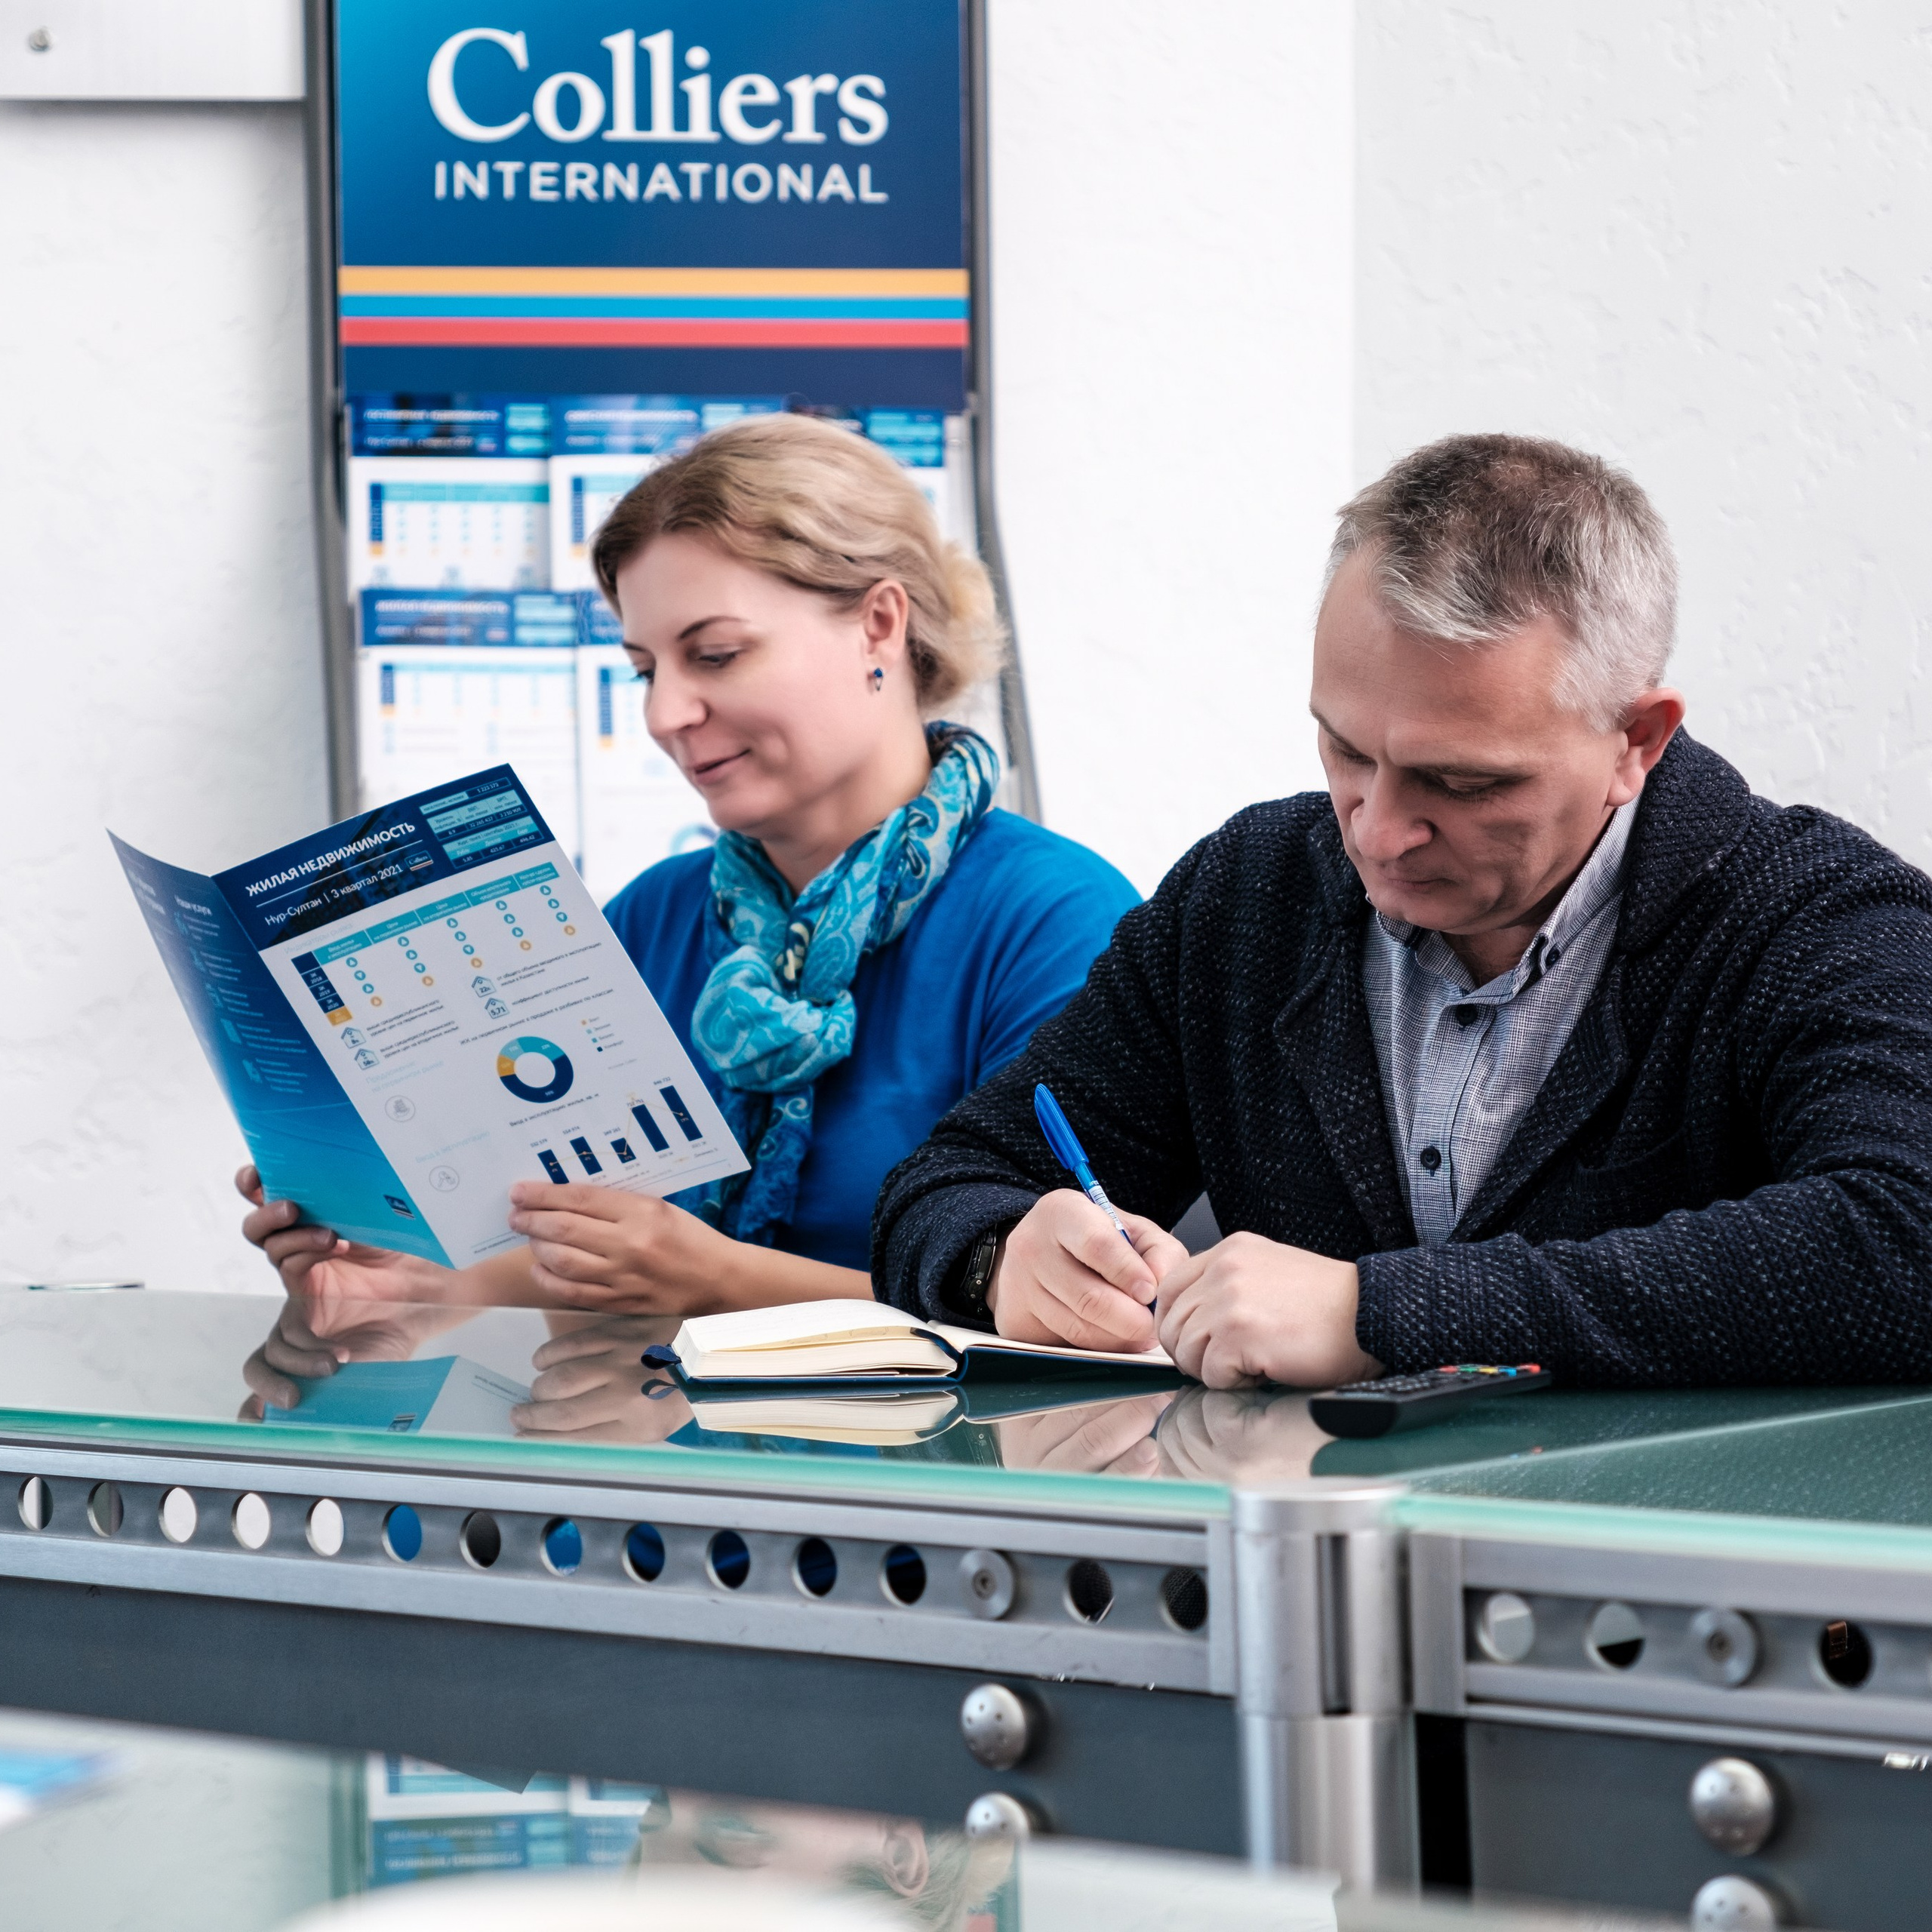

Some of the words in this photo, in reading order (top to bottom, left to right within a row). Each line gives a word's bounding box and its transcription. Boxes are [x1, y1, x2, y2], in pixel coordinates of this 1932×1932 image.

[427, 27, 889, 145] Colliers
[435, 160, 889, 204] INTERNATIONAL
[245, 866, 300, 897] ЖИЛАЯ
[297, 820, 417, 876] НЕДВИЖИМОСТЬ
[263, 895, 324, 928] Нур-Султан
[329, 888, 340, 899] 3
[338, 873, 379, 897] квартал
[376, 862, 404, 880] 2021
